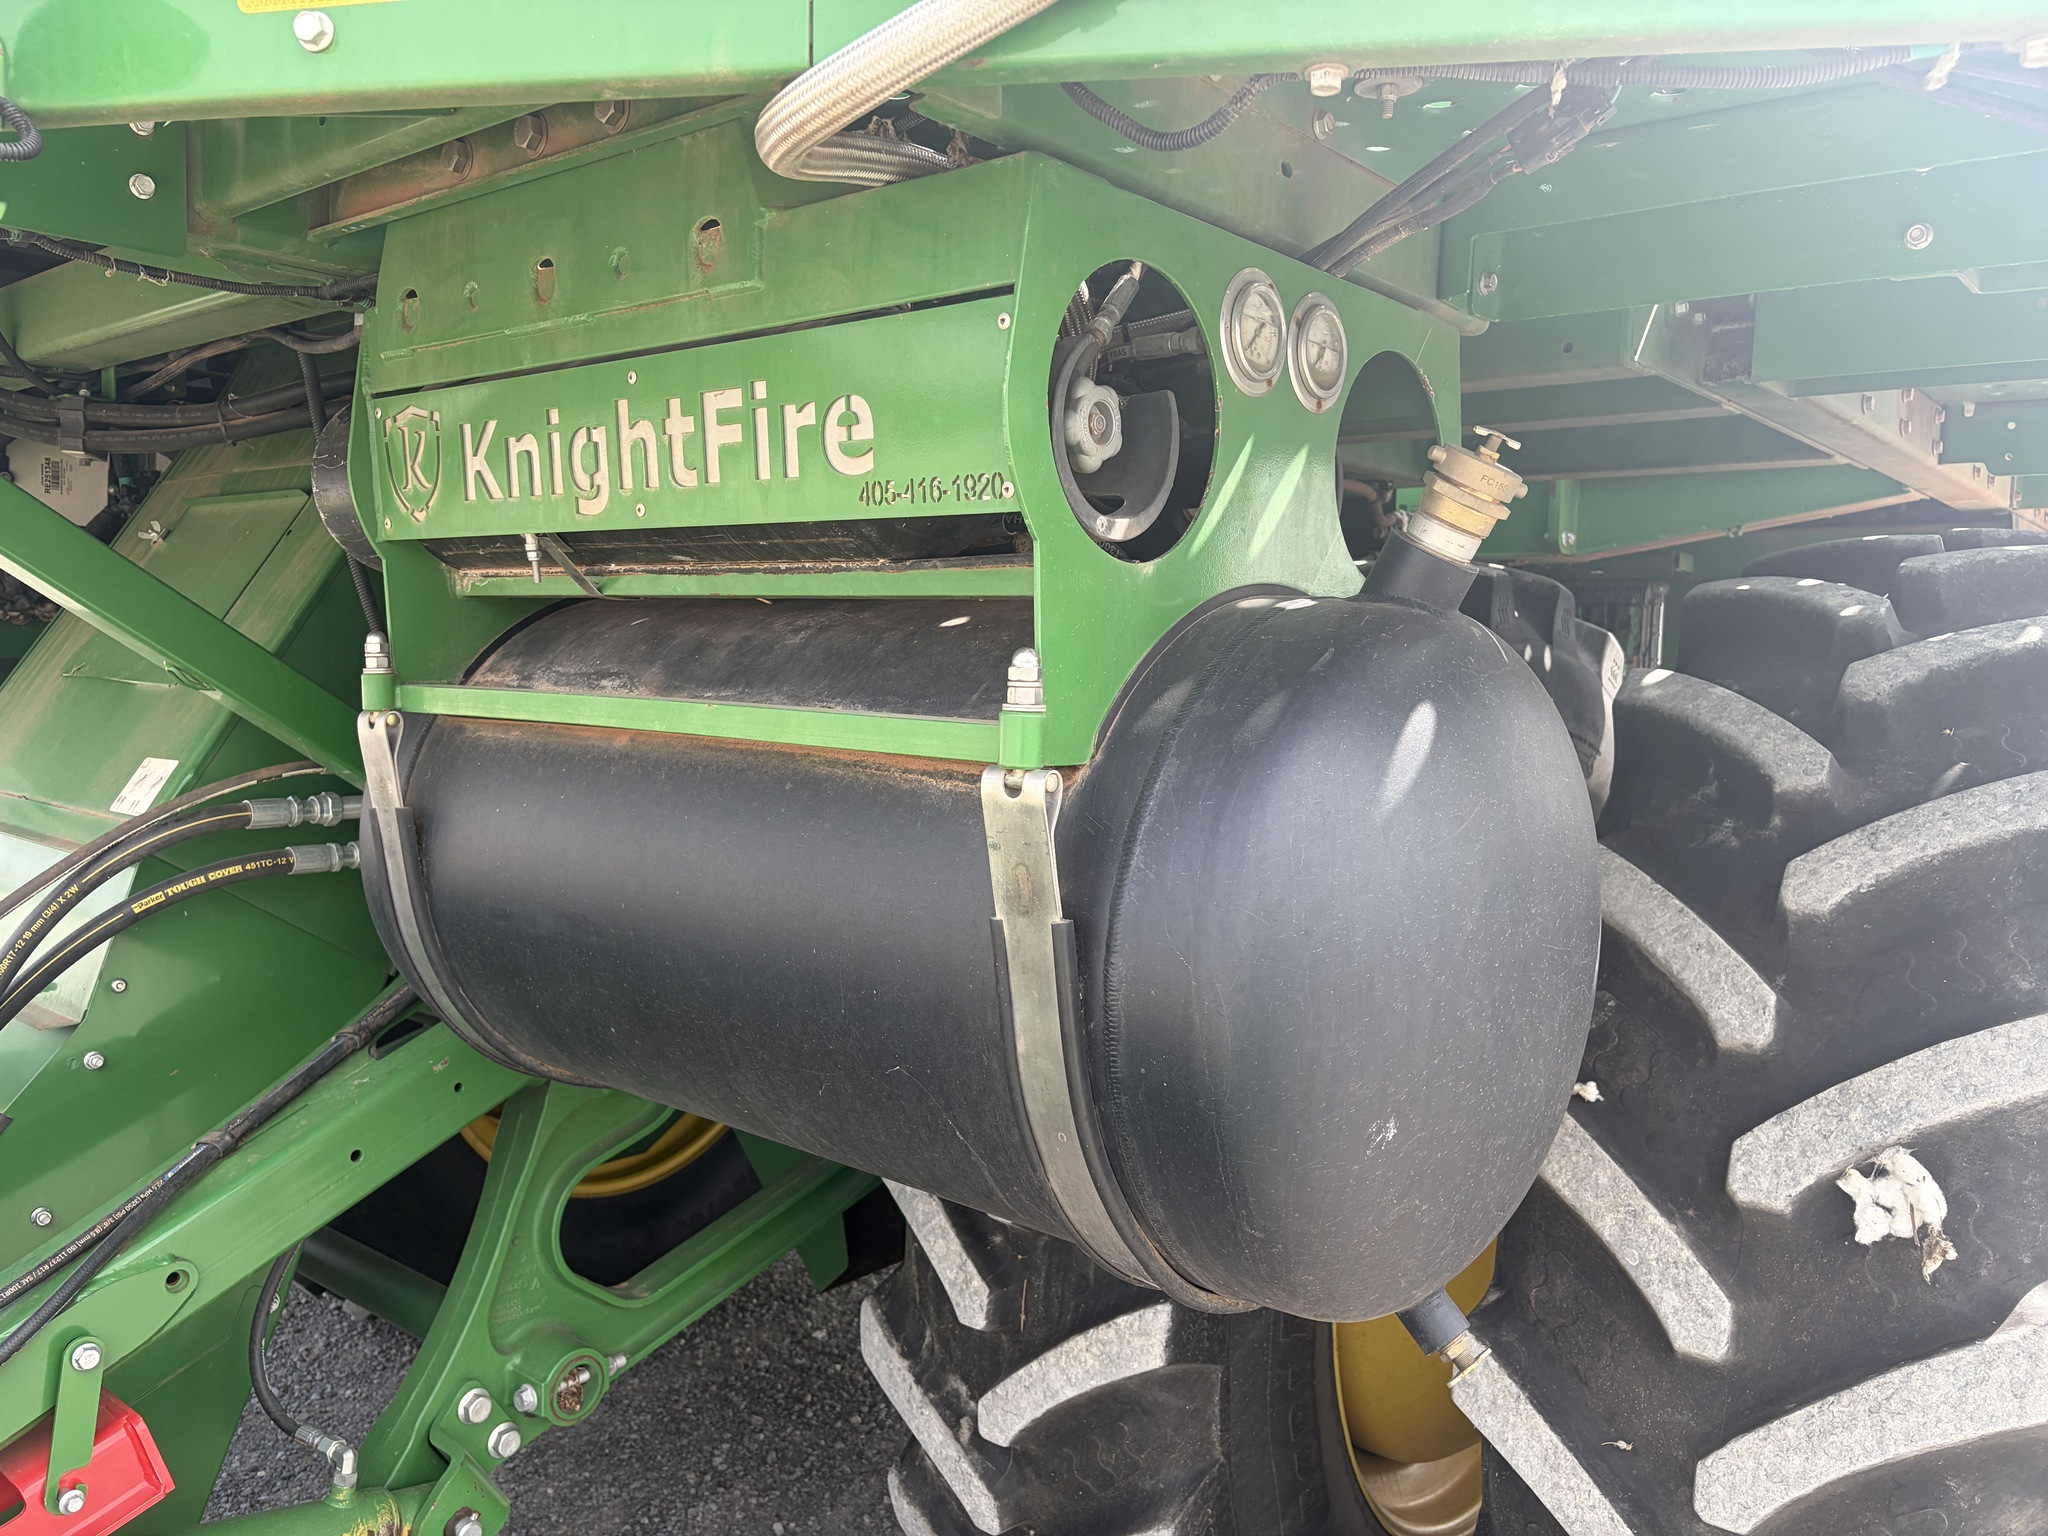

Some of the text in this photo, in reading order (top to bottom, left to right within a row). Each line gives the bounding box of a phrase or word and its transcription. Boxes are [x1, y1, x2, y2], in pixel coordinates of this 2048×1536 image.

[1109, 348, 1127, 359] FRAS
[460, 378, 875, 516] KnightFire
[44, 457, 52, 494] RE251348
[1480, 474, 1509, 493] FC150
[858, 472, 1005, 507] 405-416-1920
[134, 891, 165, 911] Parker
[165, 874, 207, 897] TOUGH
[208, 864, 244, 882] COVER
[245, 857, 287, 871] 451TC-12
[22, 931, 33, 940] 19
[30, 917, 45, 933] mm
[42, 902, 60, 919] (3/4)
[57, 896, 67, 905] X
[64, 883, 80, 899] 2W
[152, 1179, 165, 1191] 22.5
[140, 1188, 153, 1199] MPa
[66, 1244, 78, 1254] ISO
[49, 1251, 68, 1267] 11237
[37, 1265, 50, 1275] R17
[20, 1276, 34, 1287] SAE
